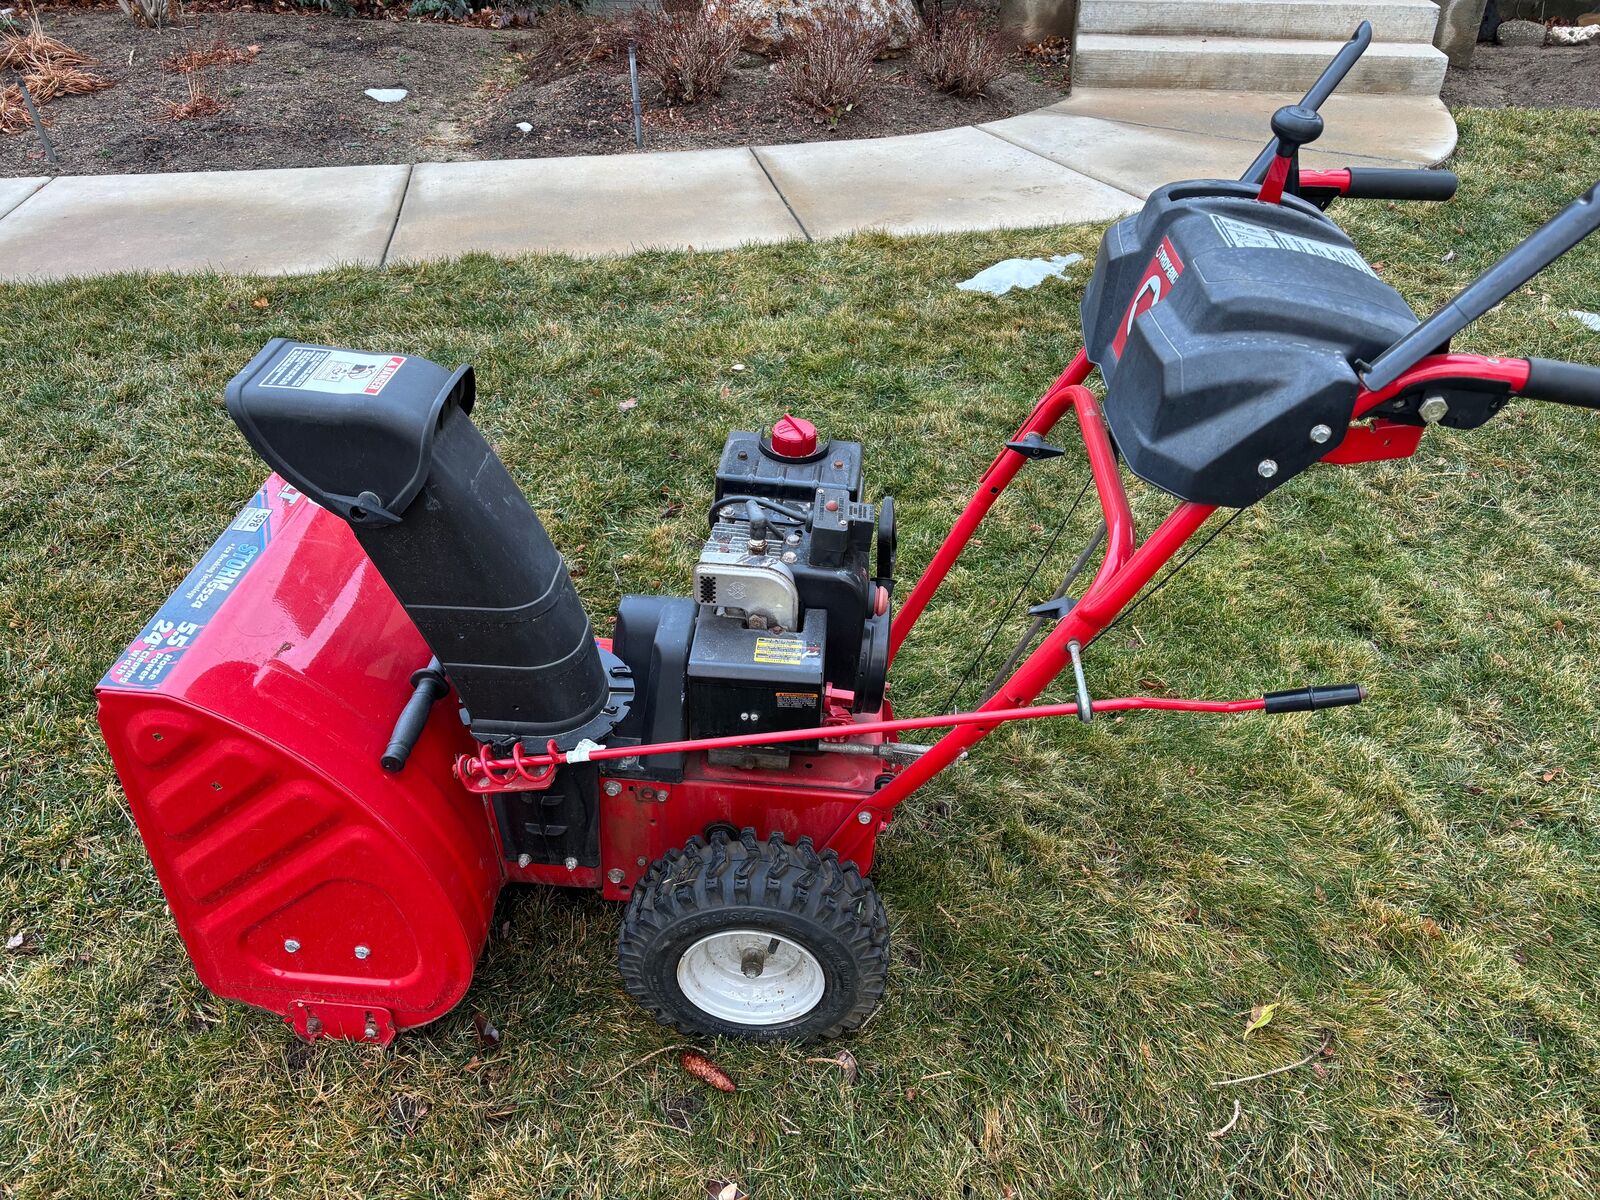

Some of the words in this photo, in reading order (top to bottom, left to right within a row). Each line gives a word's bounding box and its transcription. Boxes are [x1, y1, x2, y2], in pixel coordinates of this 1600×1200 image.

[1158, 249, 1180, 286] TROY-BIL
[368, 366, 394, 388] DANGER
[204, 553, 228, 574] Breaking
[213, 543, 258, 591] STORM
[184, 573, 212, 599] Technology
[189, 581, 218, 609] 5524
[114, 649, 141, 674] Width
[117, 650, 151, 683] Clearing
[136, 652, 164, 680] Power
[146, 654, 173, 680] Horse
